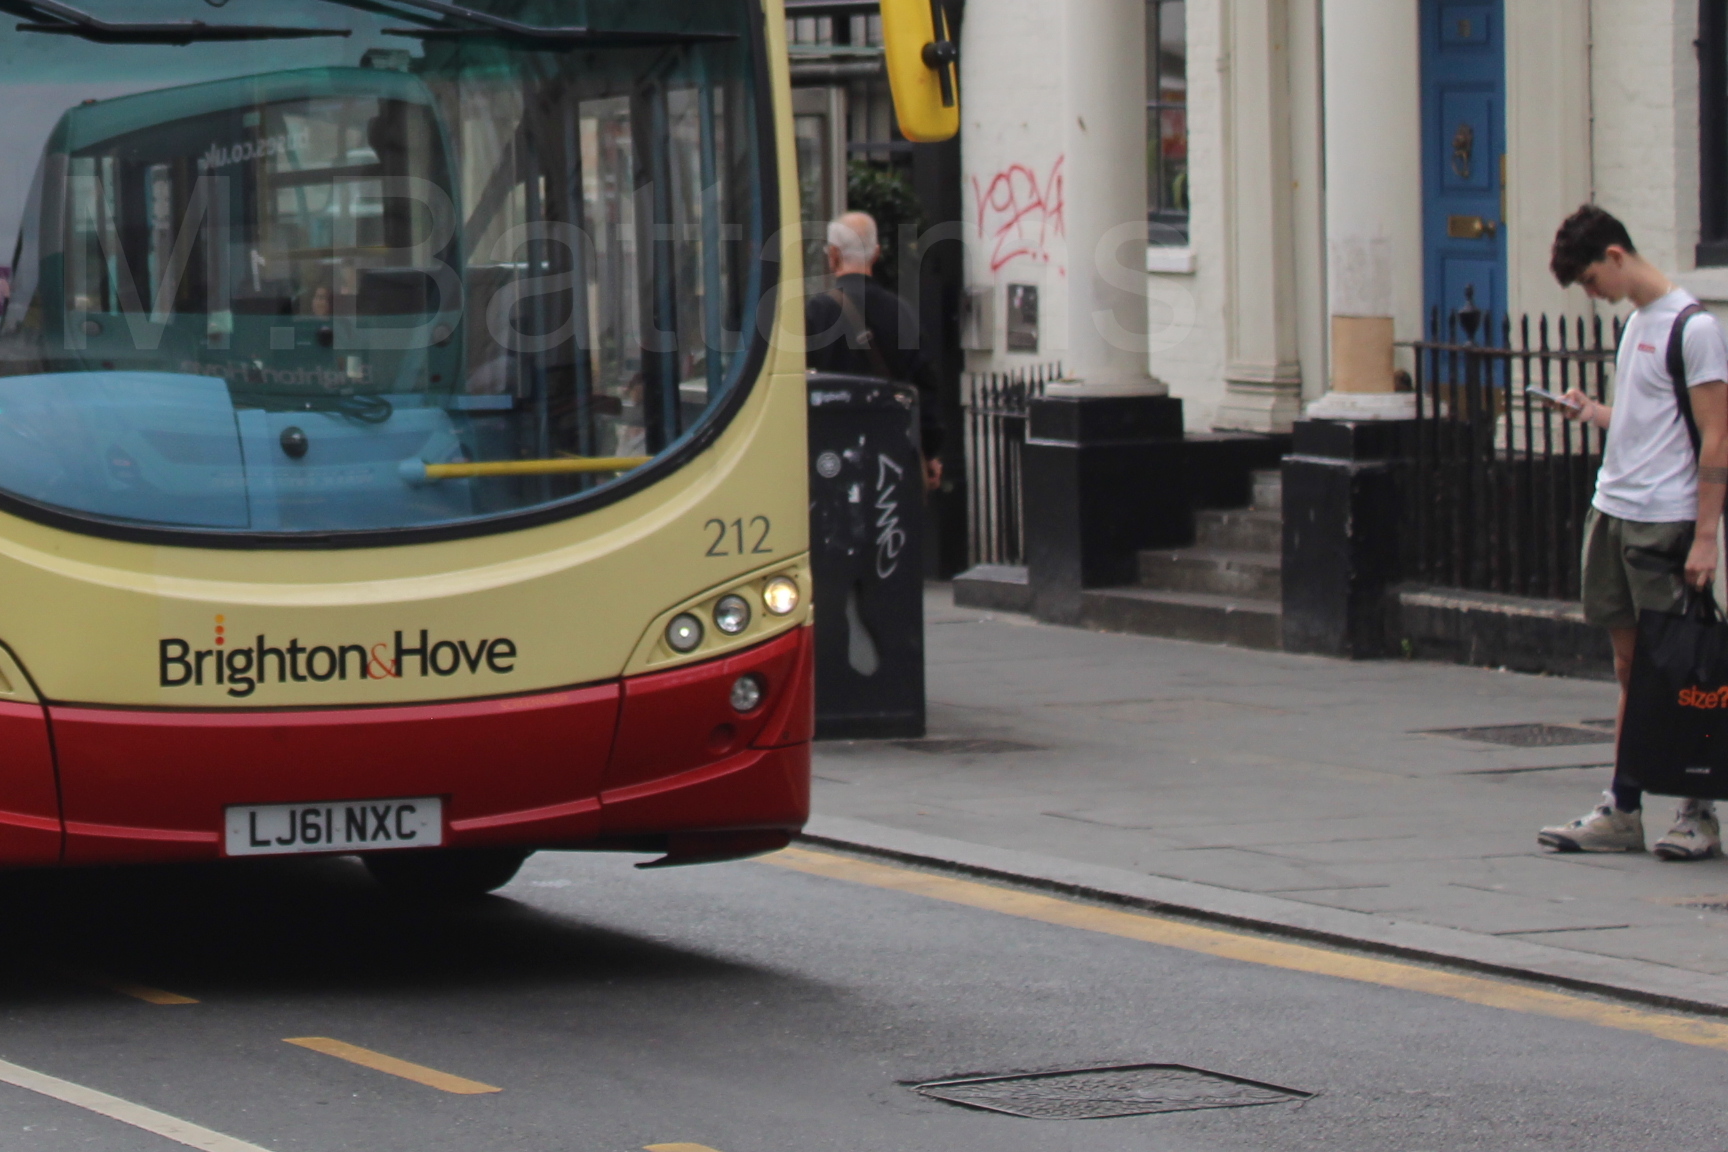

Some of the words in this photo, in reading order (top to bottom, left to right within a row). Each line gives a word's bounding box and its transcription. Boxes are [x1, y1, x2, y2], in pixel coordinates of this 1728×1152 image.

[704, 515, 773, 557] 212
[249, 809, 333, 847] LJ61
[345, 804, 417, 841] NXC
